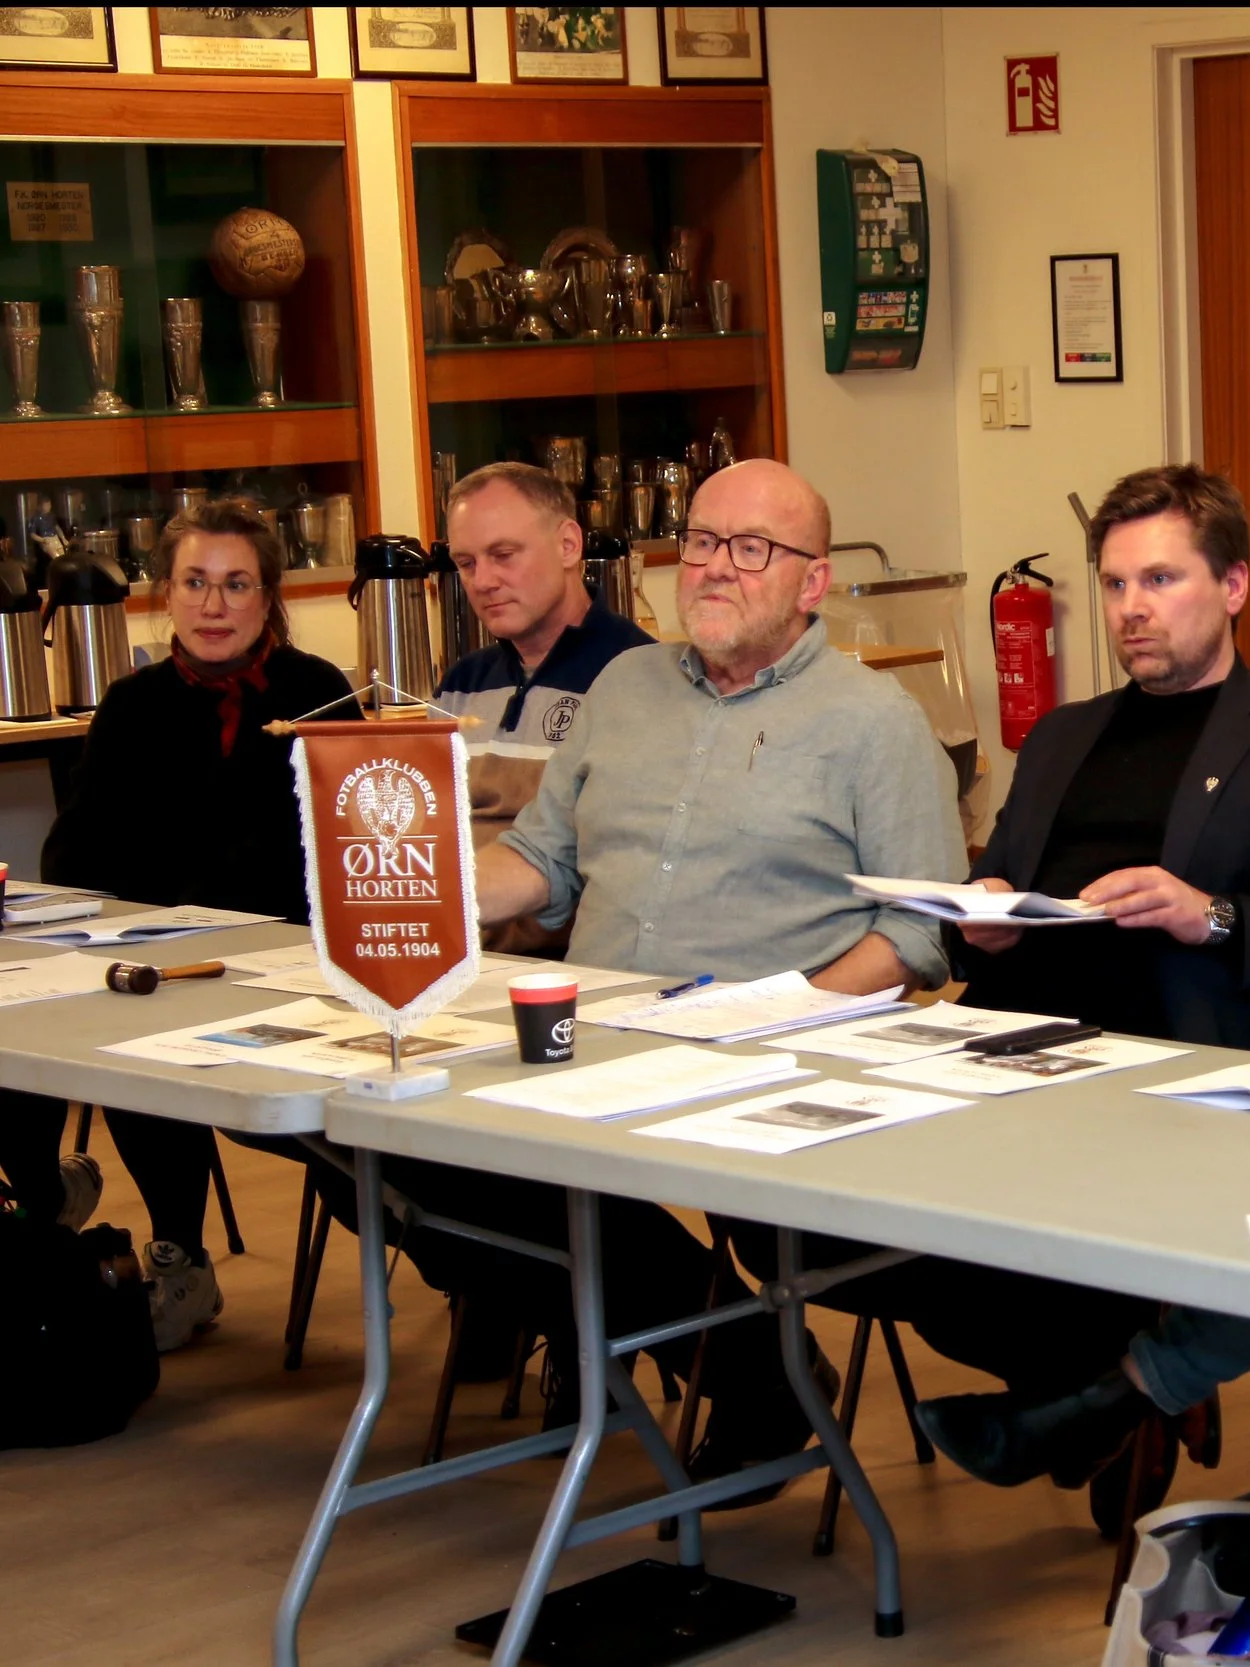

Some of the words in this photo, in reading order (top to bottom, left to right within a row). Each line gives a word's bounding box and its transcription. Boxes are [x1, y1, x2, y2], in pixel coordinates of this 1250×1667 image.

[335, 758, 437, 817] FOTBALLKLUBBEN
[342, 842, 437, 878] ØRN
[346, 879, 438, 898] HORTEN
[361, 922, 430, 938] STIFTET
[355, 942, 440, 958] 04.05.1904
